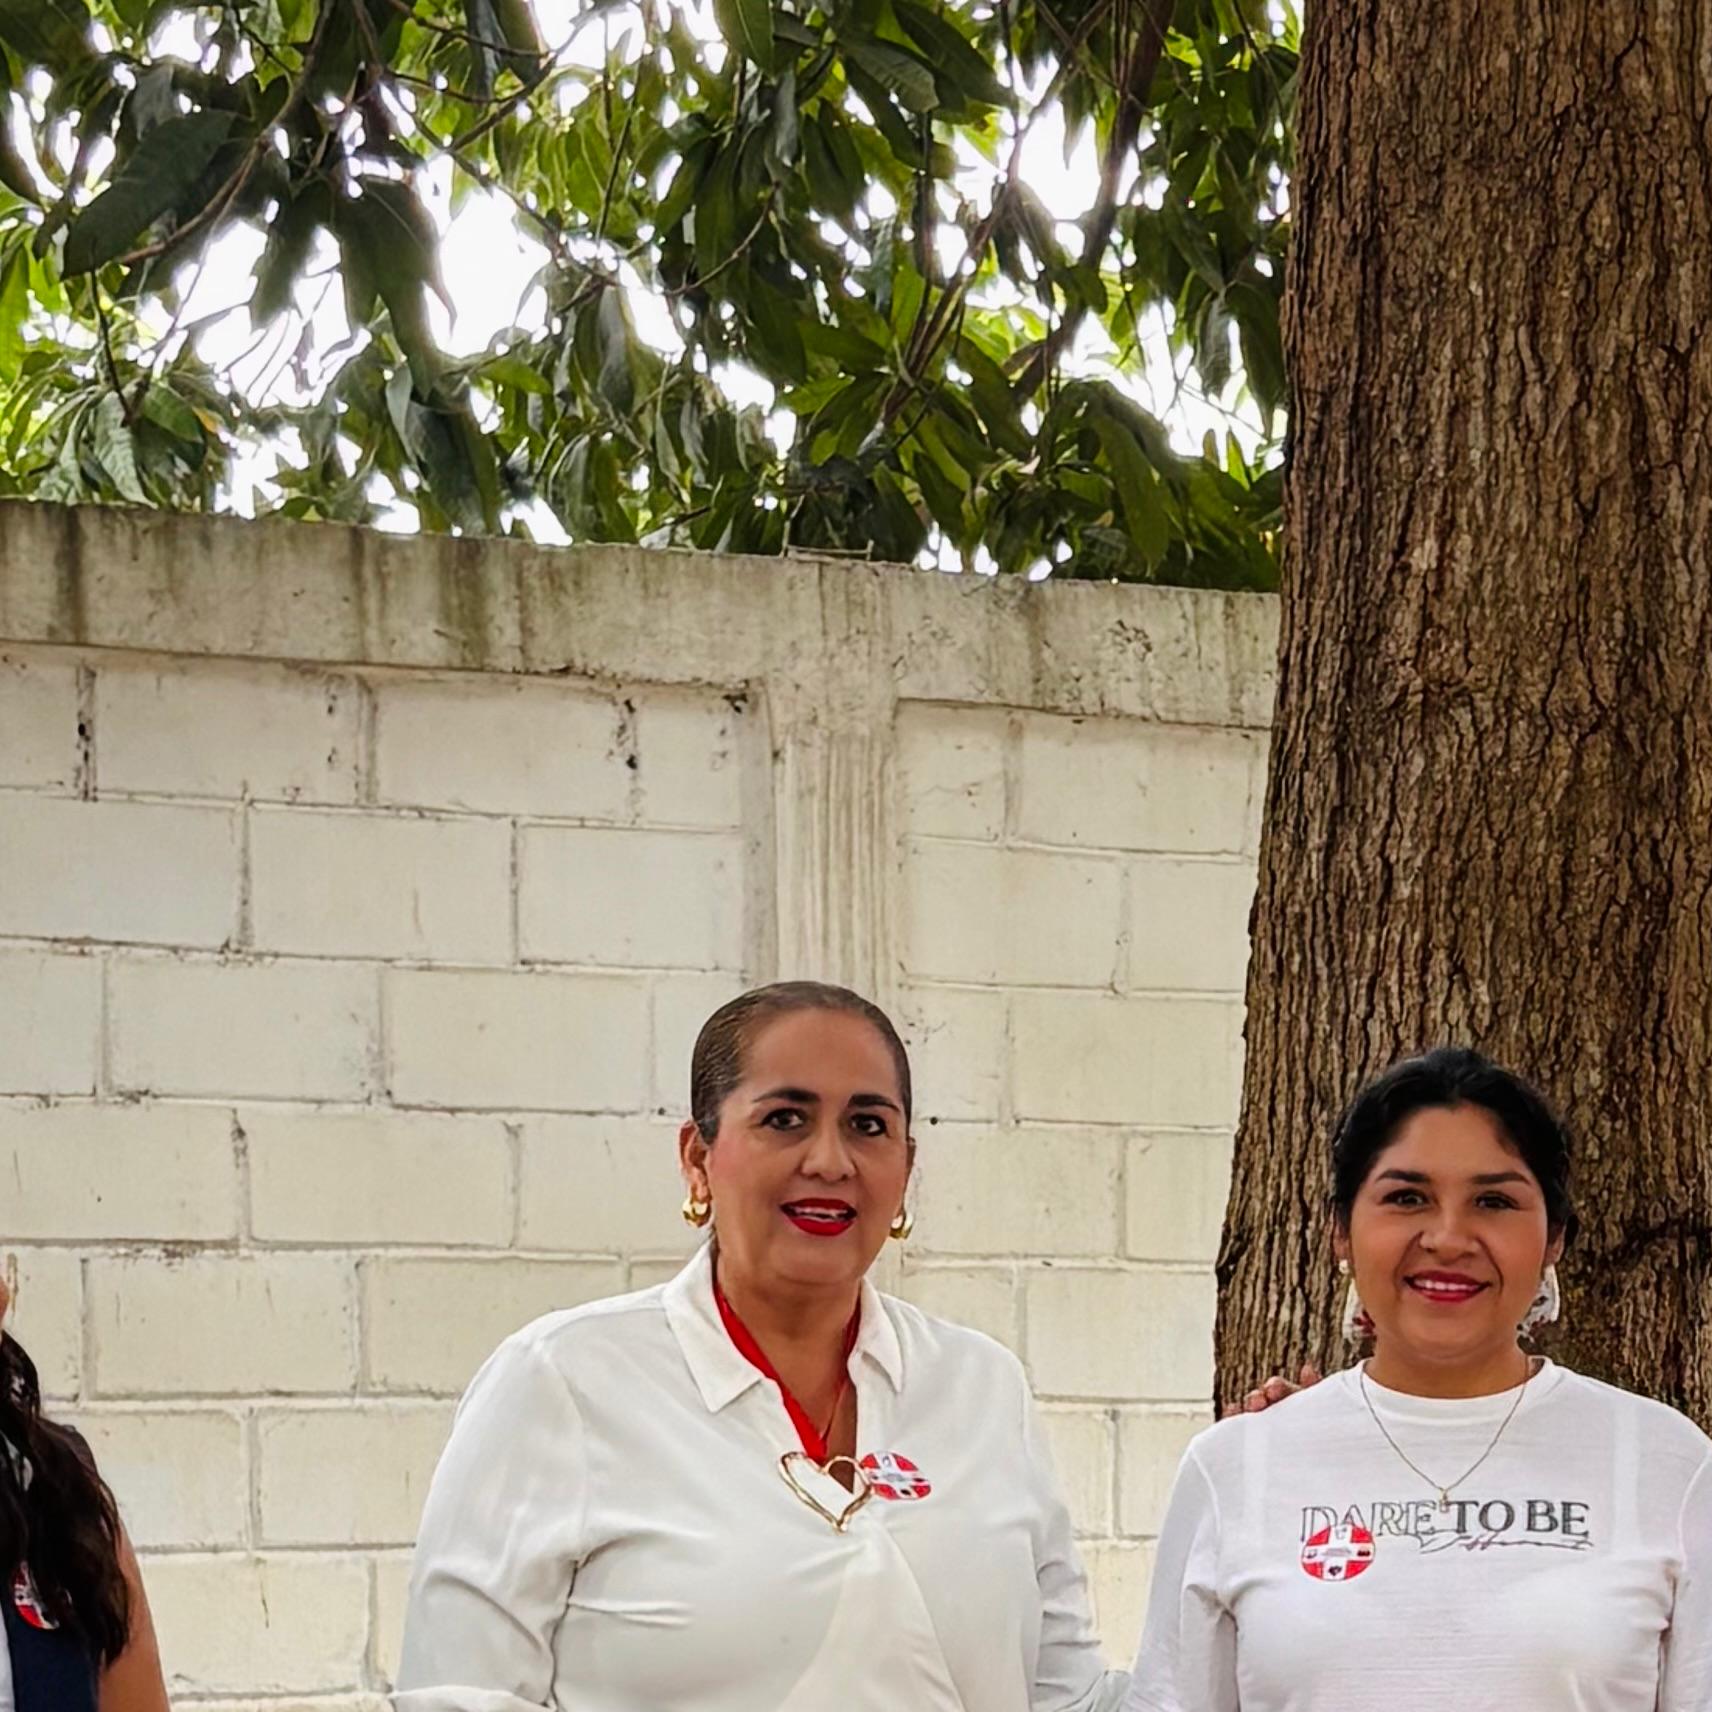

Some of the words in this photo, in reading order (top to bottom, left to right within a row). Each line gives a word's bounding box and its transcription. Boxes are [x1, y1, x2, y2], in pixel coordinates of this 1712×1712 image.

[1301, 1499, 1437, 1541] DARE
[1447, 1499, 1514, 1534] TO
[1526, 1499, 1590, 1538] BE
